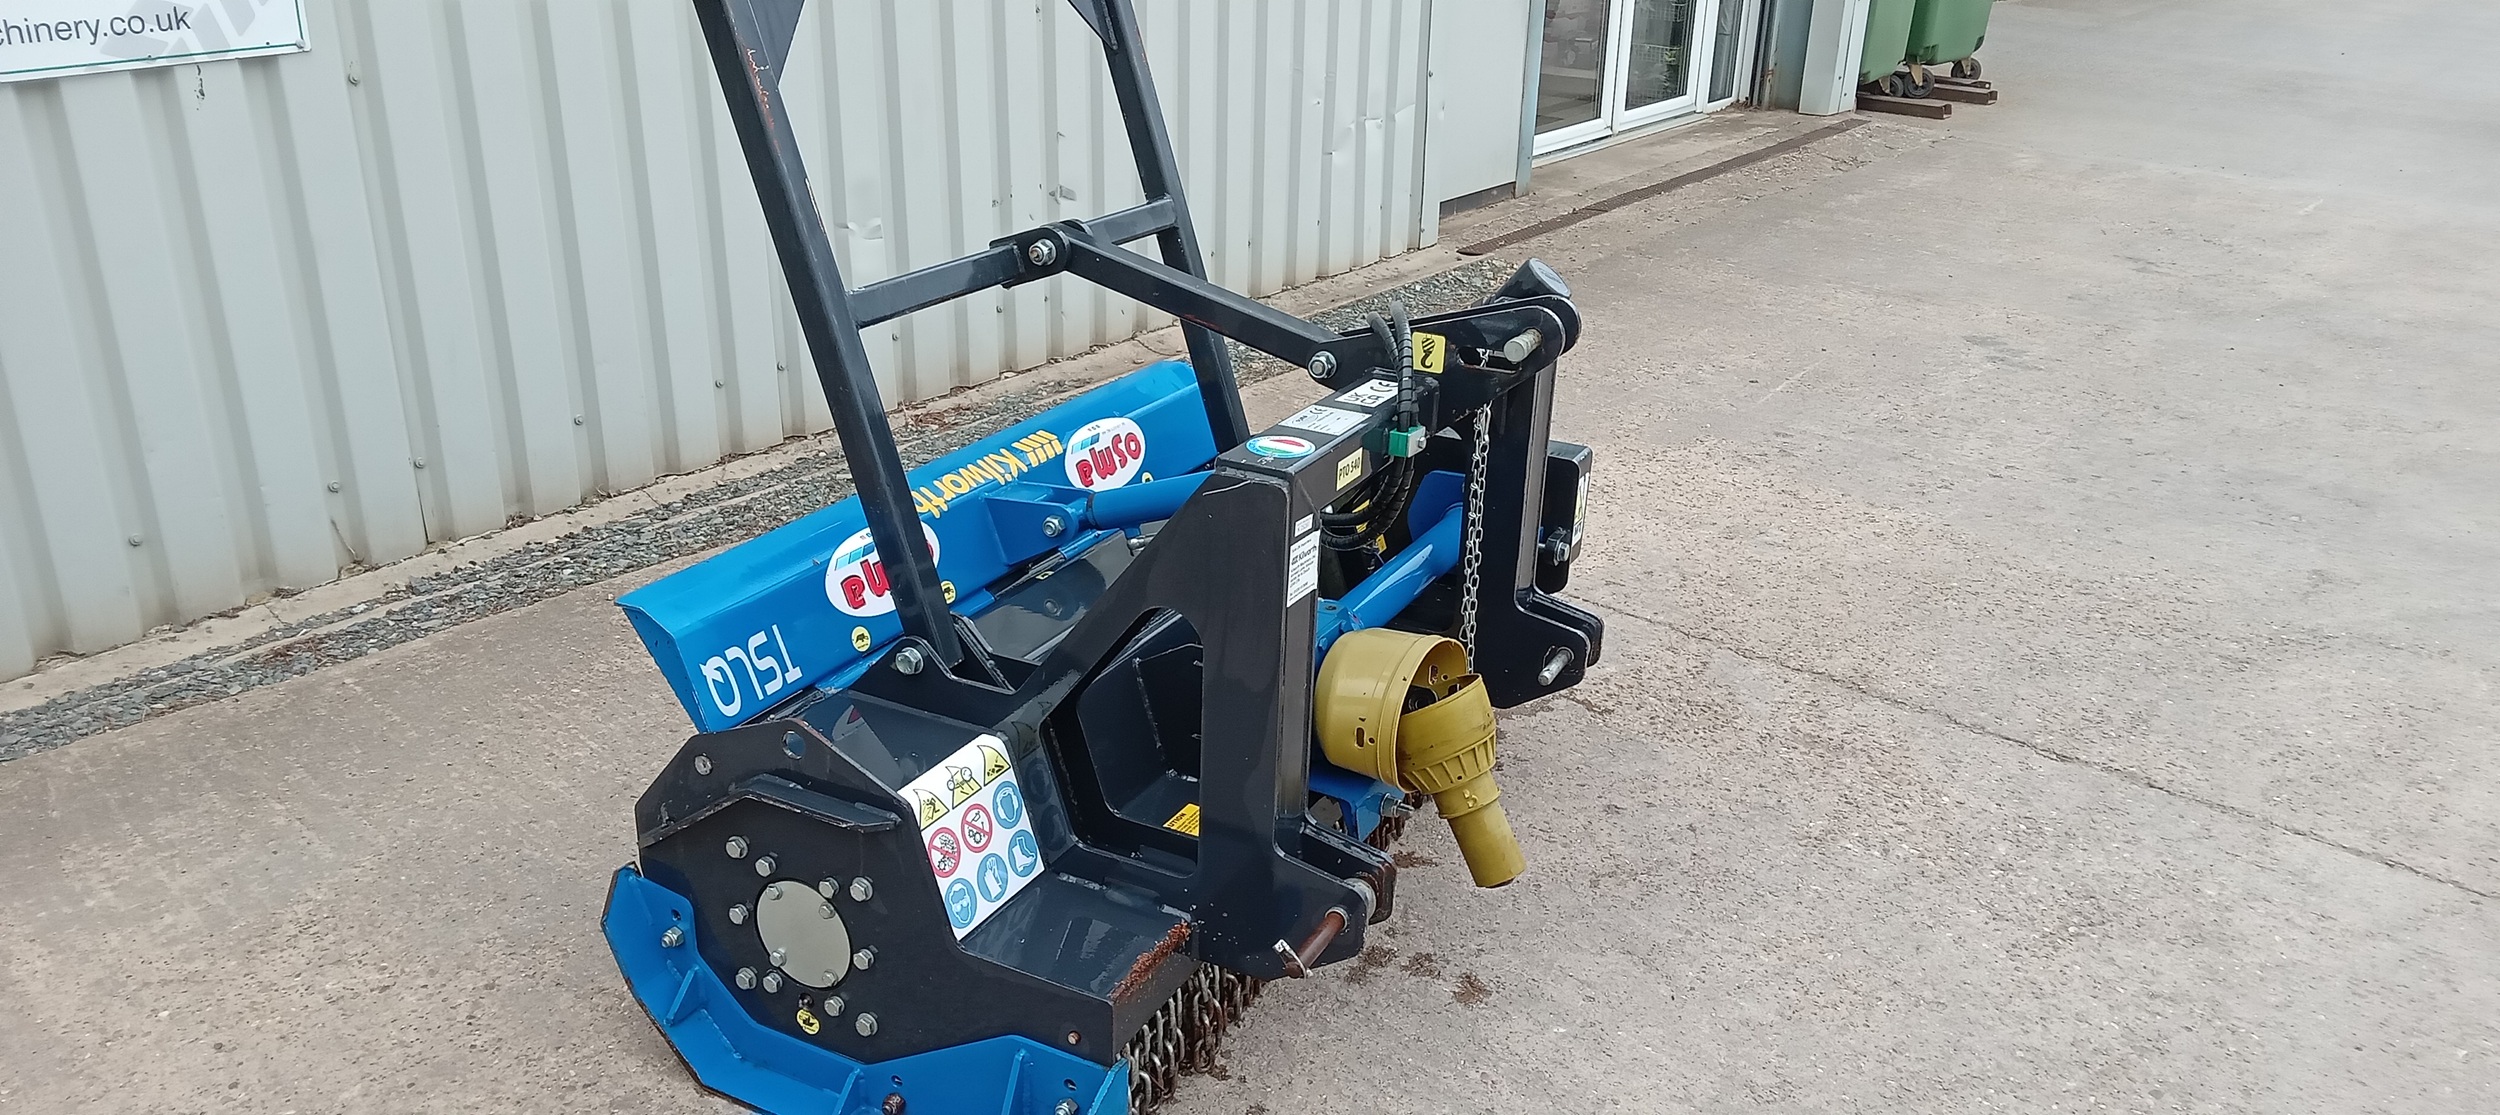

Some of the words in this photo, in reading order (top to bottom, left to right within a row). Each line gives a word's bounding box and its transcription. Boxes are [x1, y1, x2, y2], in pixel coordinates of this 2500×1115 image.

[911, 448, 1028, 519] Kilworth
[1076, 432, 1141, 488] osma
[1338, 463, 1350, 481] PTO
[1350, 457, 1361, 474] 540
